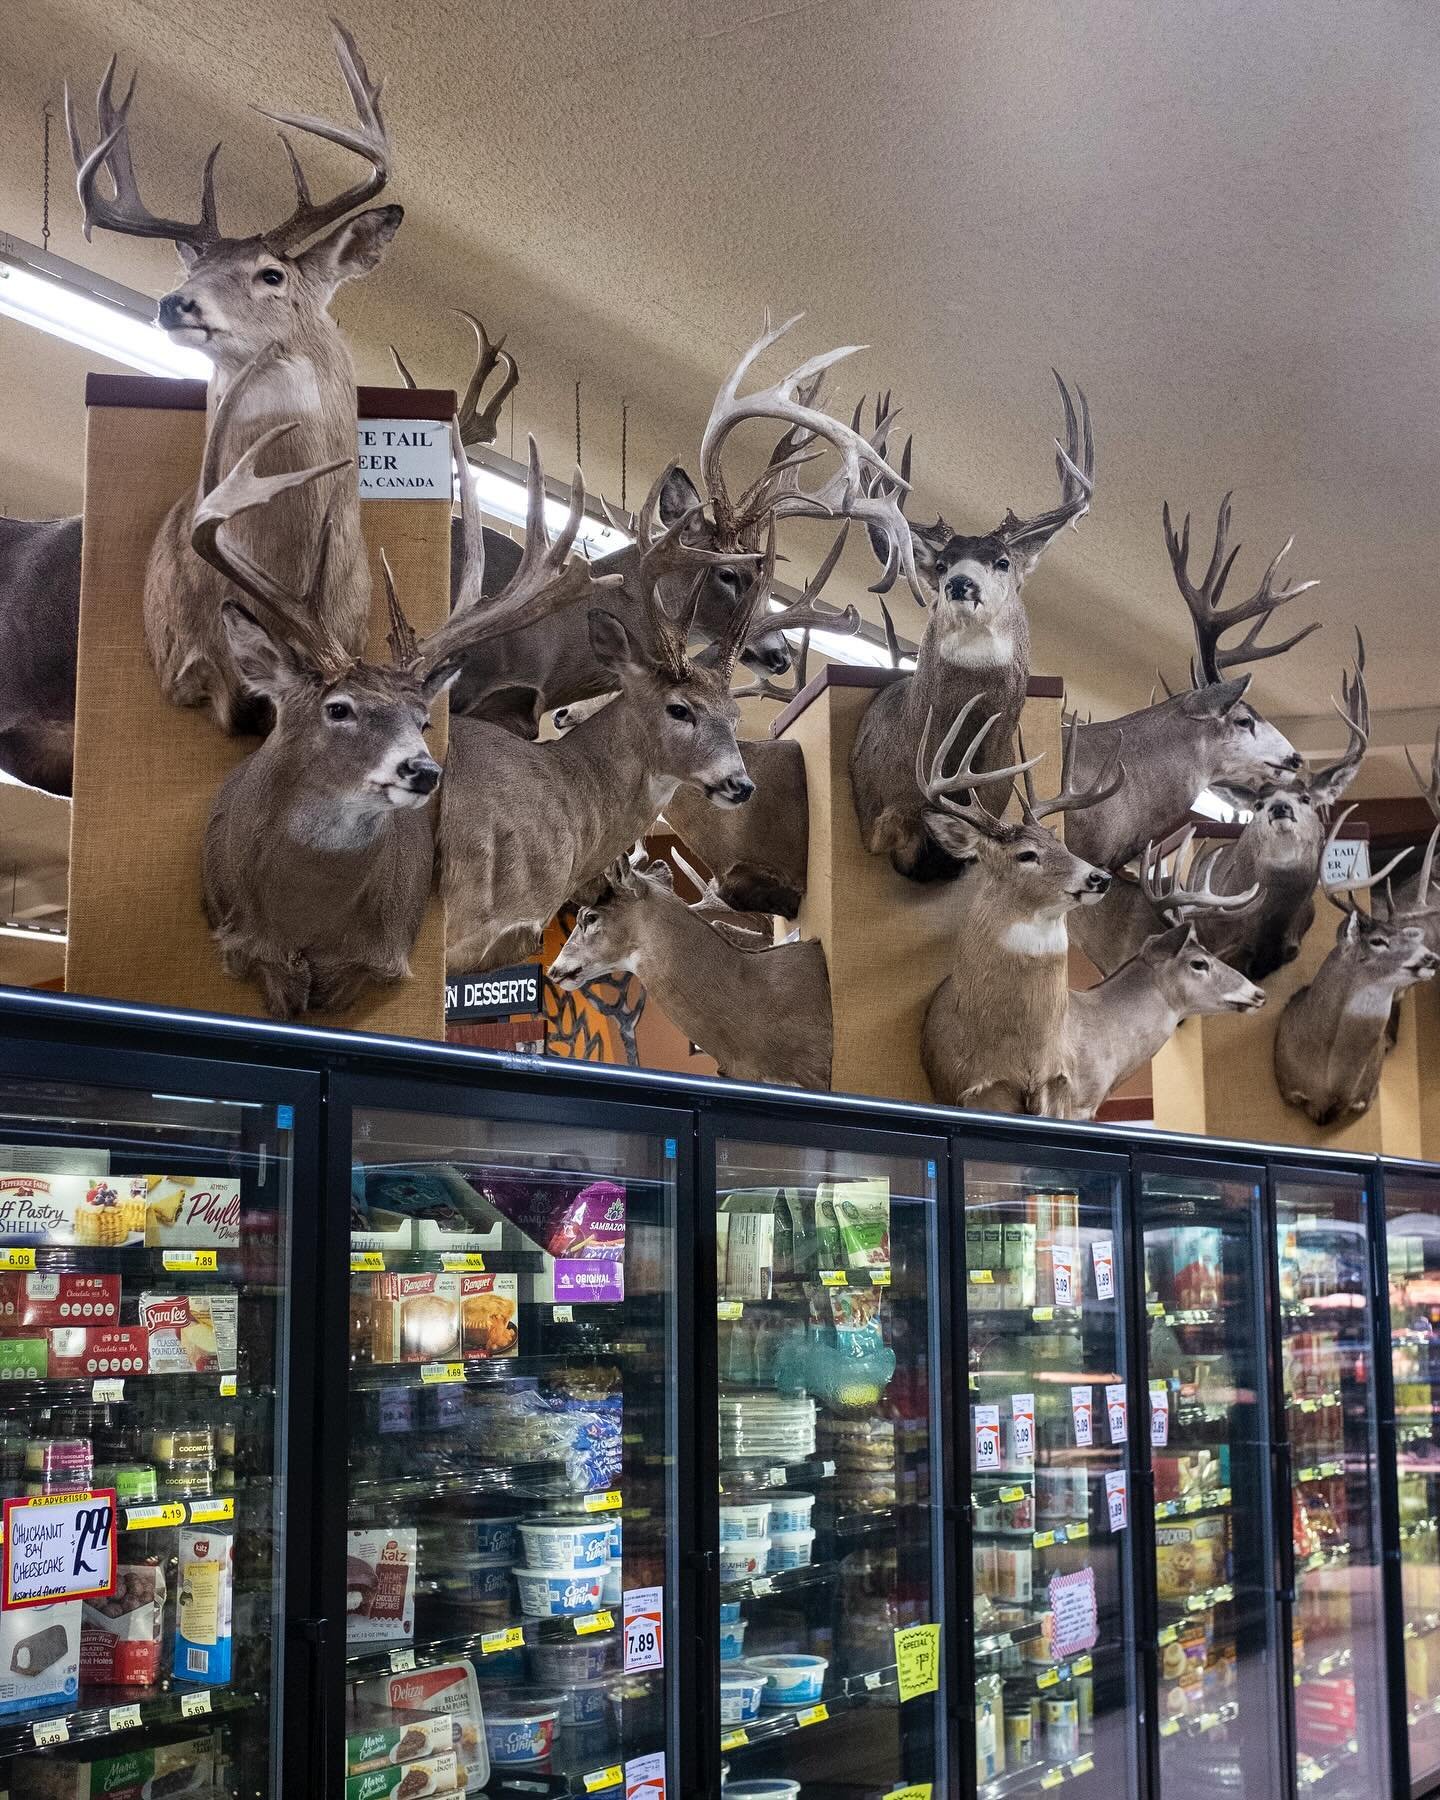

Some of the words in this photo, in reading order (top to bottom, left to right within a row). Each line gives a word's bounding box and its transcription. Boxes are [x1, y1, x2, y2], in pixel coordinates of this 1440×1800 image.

[383, 432, 433, 447] TAIL
[359, 456, 398, 470] EER
[376, 477, 434, 487] CANADA
[445, 985, 458, 1009] N
[464, 978, 537, 1007] DESSERTS
[1, 1180, 32, 1189] PEPPERIDGE
[33, 1180, 48, 1189] FARM
[18, 1200, 69, 1229] Pastry
[0, 1220, 50, 1233] SHELLS
[9, 1255, 30, 1265] 6.09
[194, 1256, 213, 1266] 7.89
[463, 1277, 492, 1292] Banquet
[575, 1273, 610, 1284] ORIGINAL
[403, 1278, 432, 1293] Banquet
[66, 1288, 91, 1298] Chocolate
[101, 1288, 110, 1297] Pie
[92, 1344, 118, 1353] Chocolate
[129, 1343, 138, 1353] Pie
[157, 1339, 180, 1348] CLASSIC
[152, 1347, 171, 1356] POUND
[447, 1368, 461, 1377] 1.69
[179, 1445, 207, 1453] COCONUT
[977, 1440, 994, 1456] 4.99
[45, 1494, 88, 1504] ADVERTISED
[162, 1509, 182, 1519] 4.19
[13, 1523, 64, 1546] CHUCKANUT
[25, 1542, 43, 1559] BAY
[381, 1550, 408, 1562] katz
[13, 1556, 64, 1584] CHEESECAKE
[43, 1585, 67, 1598] flavors
[564, 1583, 588, 1598] Cool
[628, 1632, 655, 1654] 7.89
[903, 1638, 928, 1650] SPECIAL
[94, 1657, 113, 1665] Holes
[391, 1684, 424, 1702] Delizza
[444, 1693, 469, 1704] BELGIAN
[188, 1705, 205, 1715] 5.69
[117, 1719, 135, 1729] 5.69
[363, 1734, 386, 1748] Marie
[508, 1729, 532, 1744] Cool
[363, 1774, 386, 1788] Marie
